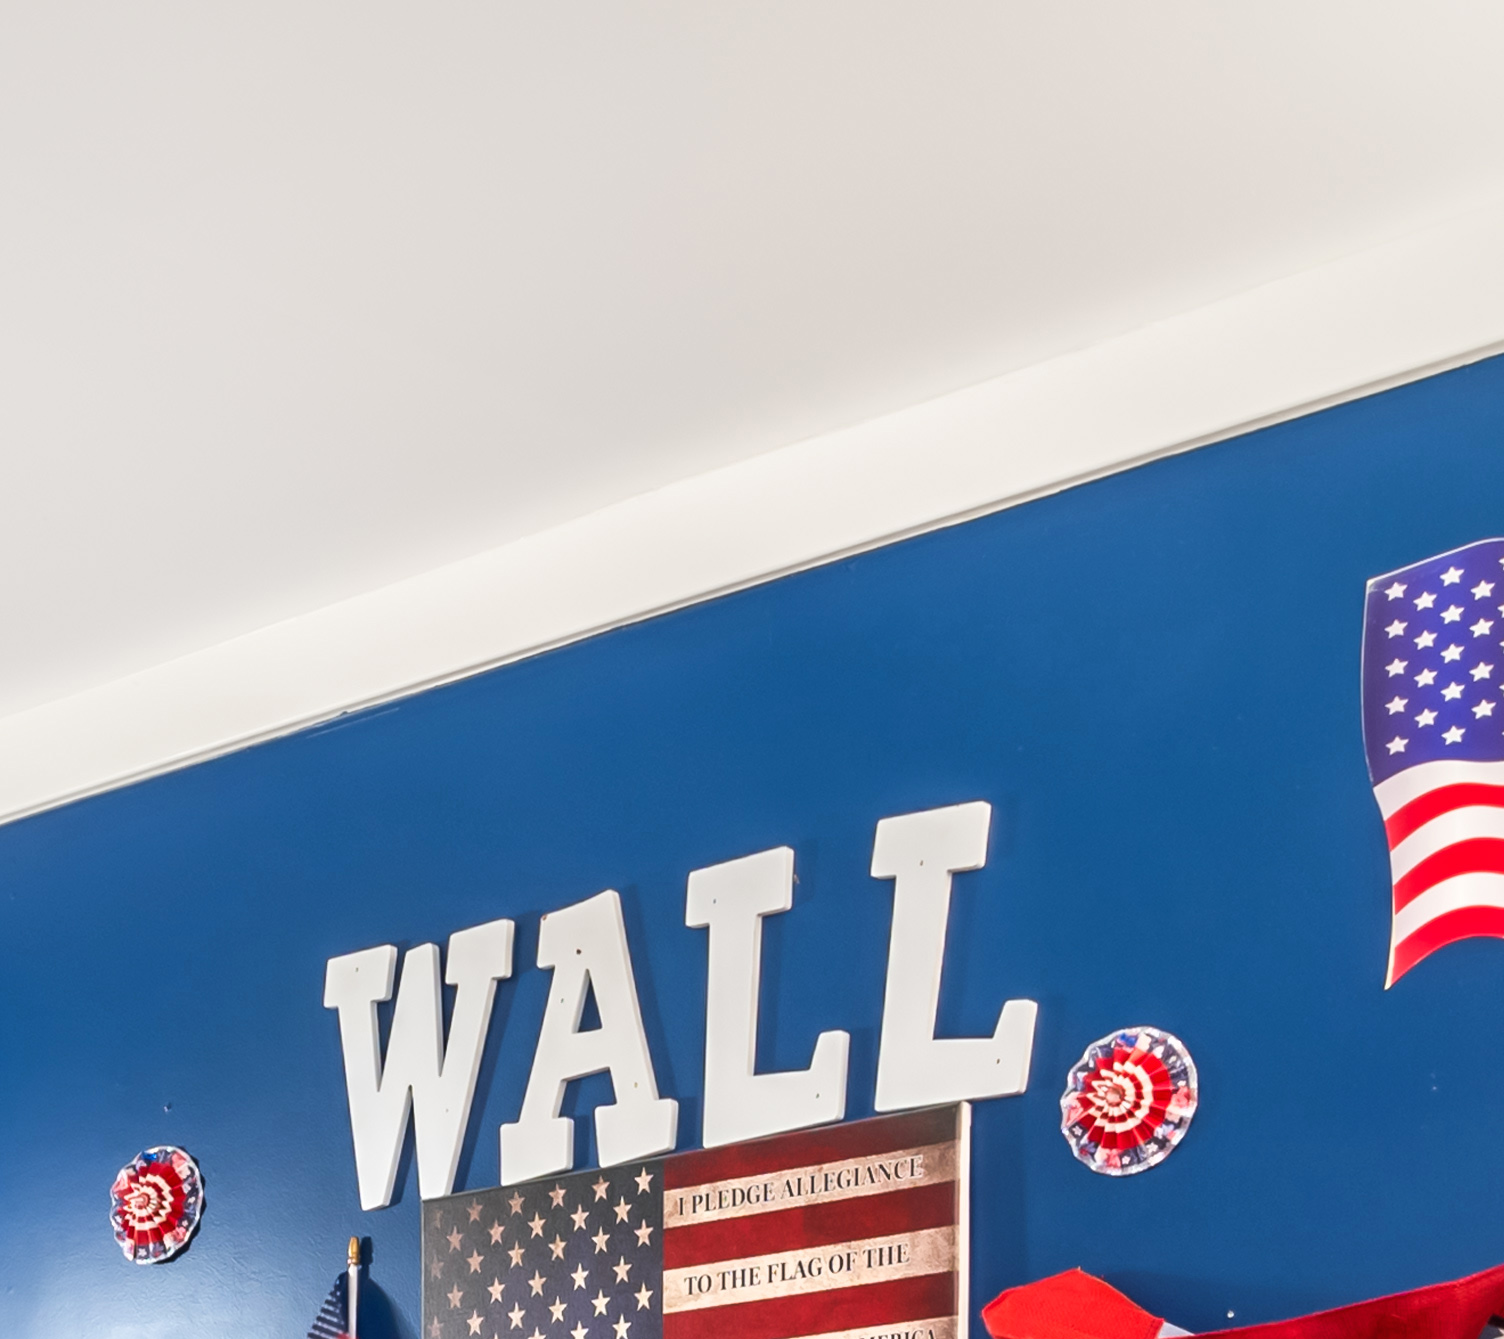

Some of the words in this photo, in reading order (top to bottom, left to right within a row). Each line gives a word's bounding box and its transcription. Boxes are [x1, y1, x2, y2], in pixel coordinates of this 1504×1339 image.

[323, 800, 1037, 1211] WALL
[678, 1197, 685, 1215] I
[691, 1181, 776, 1214] PLEDGE
[780, 1155, 924, 1199] ALLEGIANCE
[684, 1274, 712, 1296] TO
[717, 1265, 761, 1289] THE
[767, 1257, 823, 1284] FLAG
[828, 1250, 858, 1274] OF
[862, 1243, 911, 1268] THE
